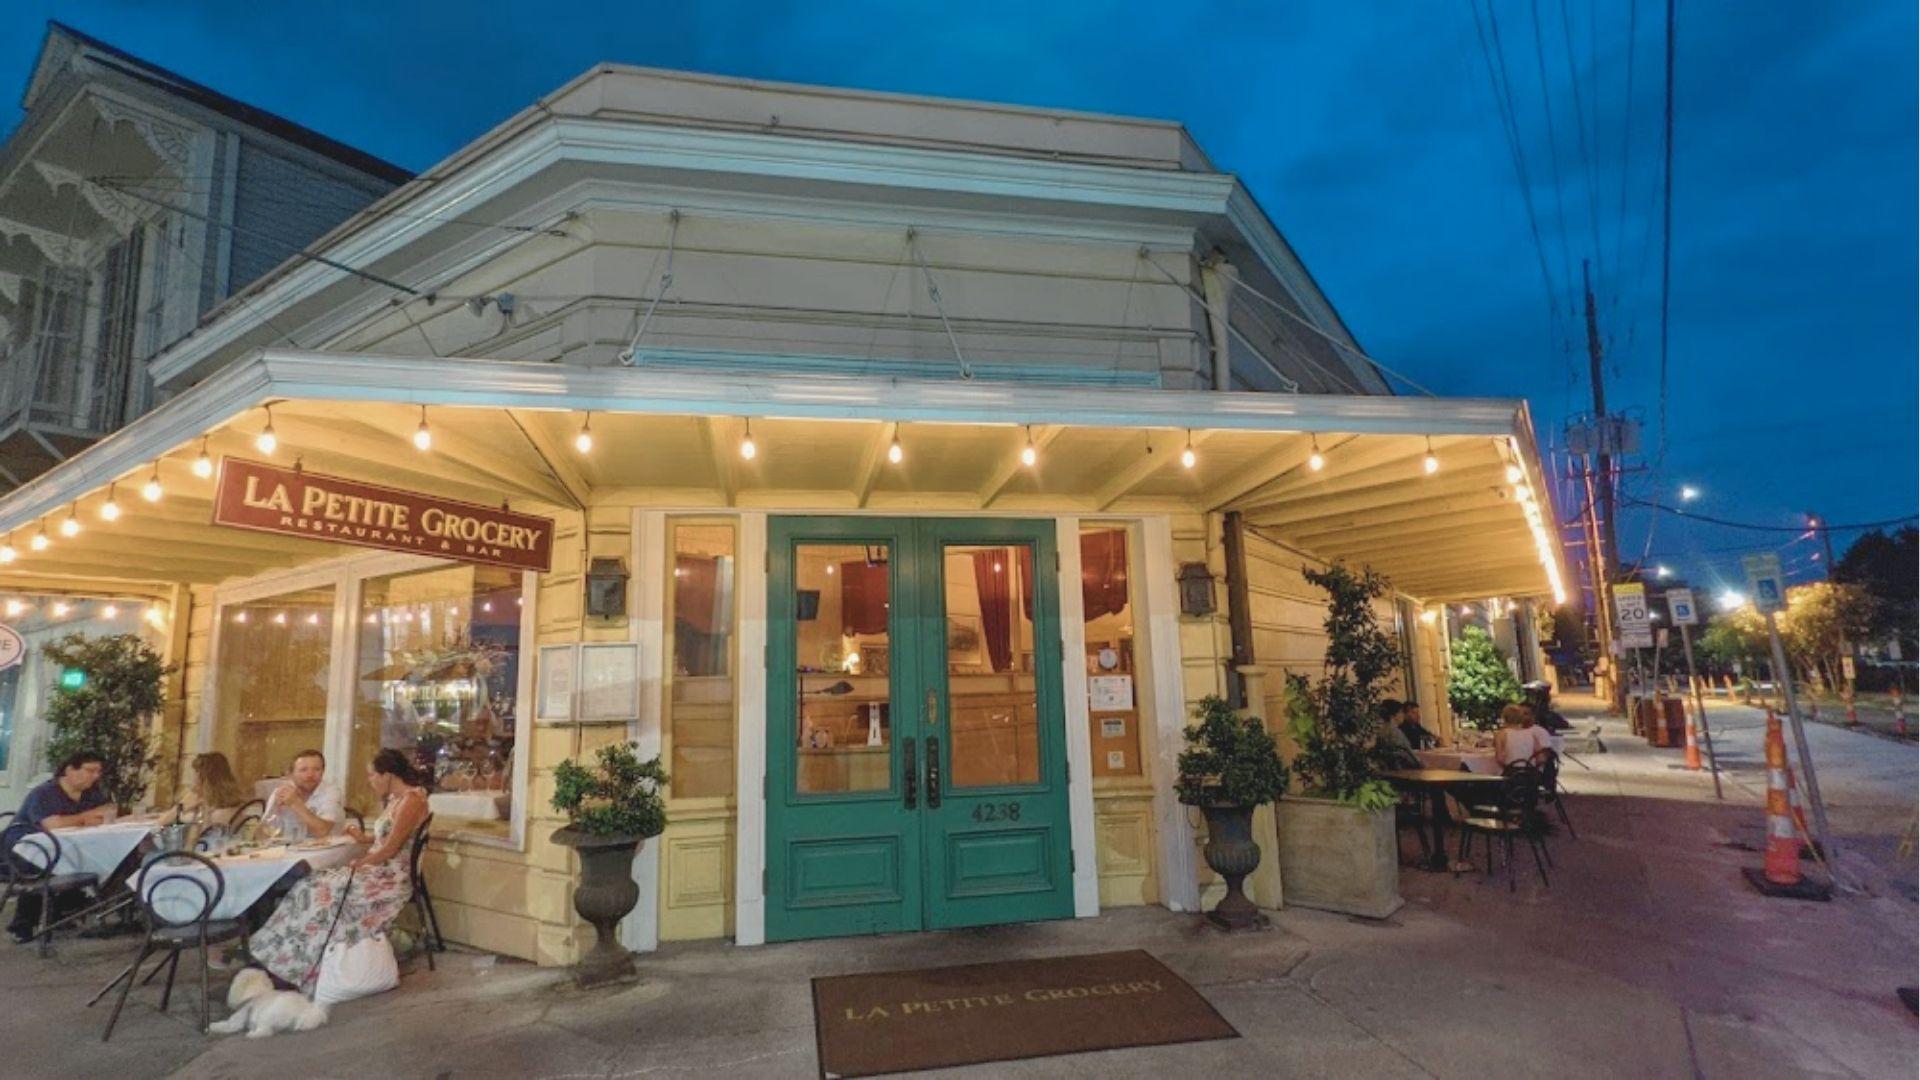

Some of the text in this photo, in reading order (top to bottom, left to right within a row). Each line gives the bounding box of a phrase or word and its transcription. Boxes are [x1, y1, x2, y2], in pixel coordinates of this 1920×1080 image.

[242, 475, 543, 551] LA PETITE GROCERY
[279, 515, 502, 557] RESTAURANT & BAR
[1621, 607, 1644, 620] 20
[971, 801, 1021, 823] 4238
[844, 980, 1165, 1021] LA PETITE GROCERY
